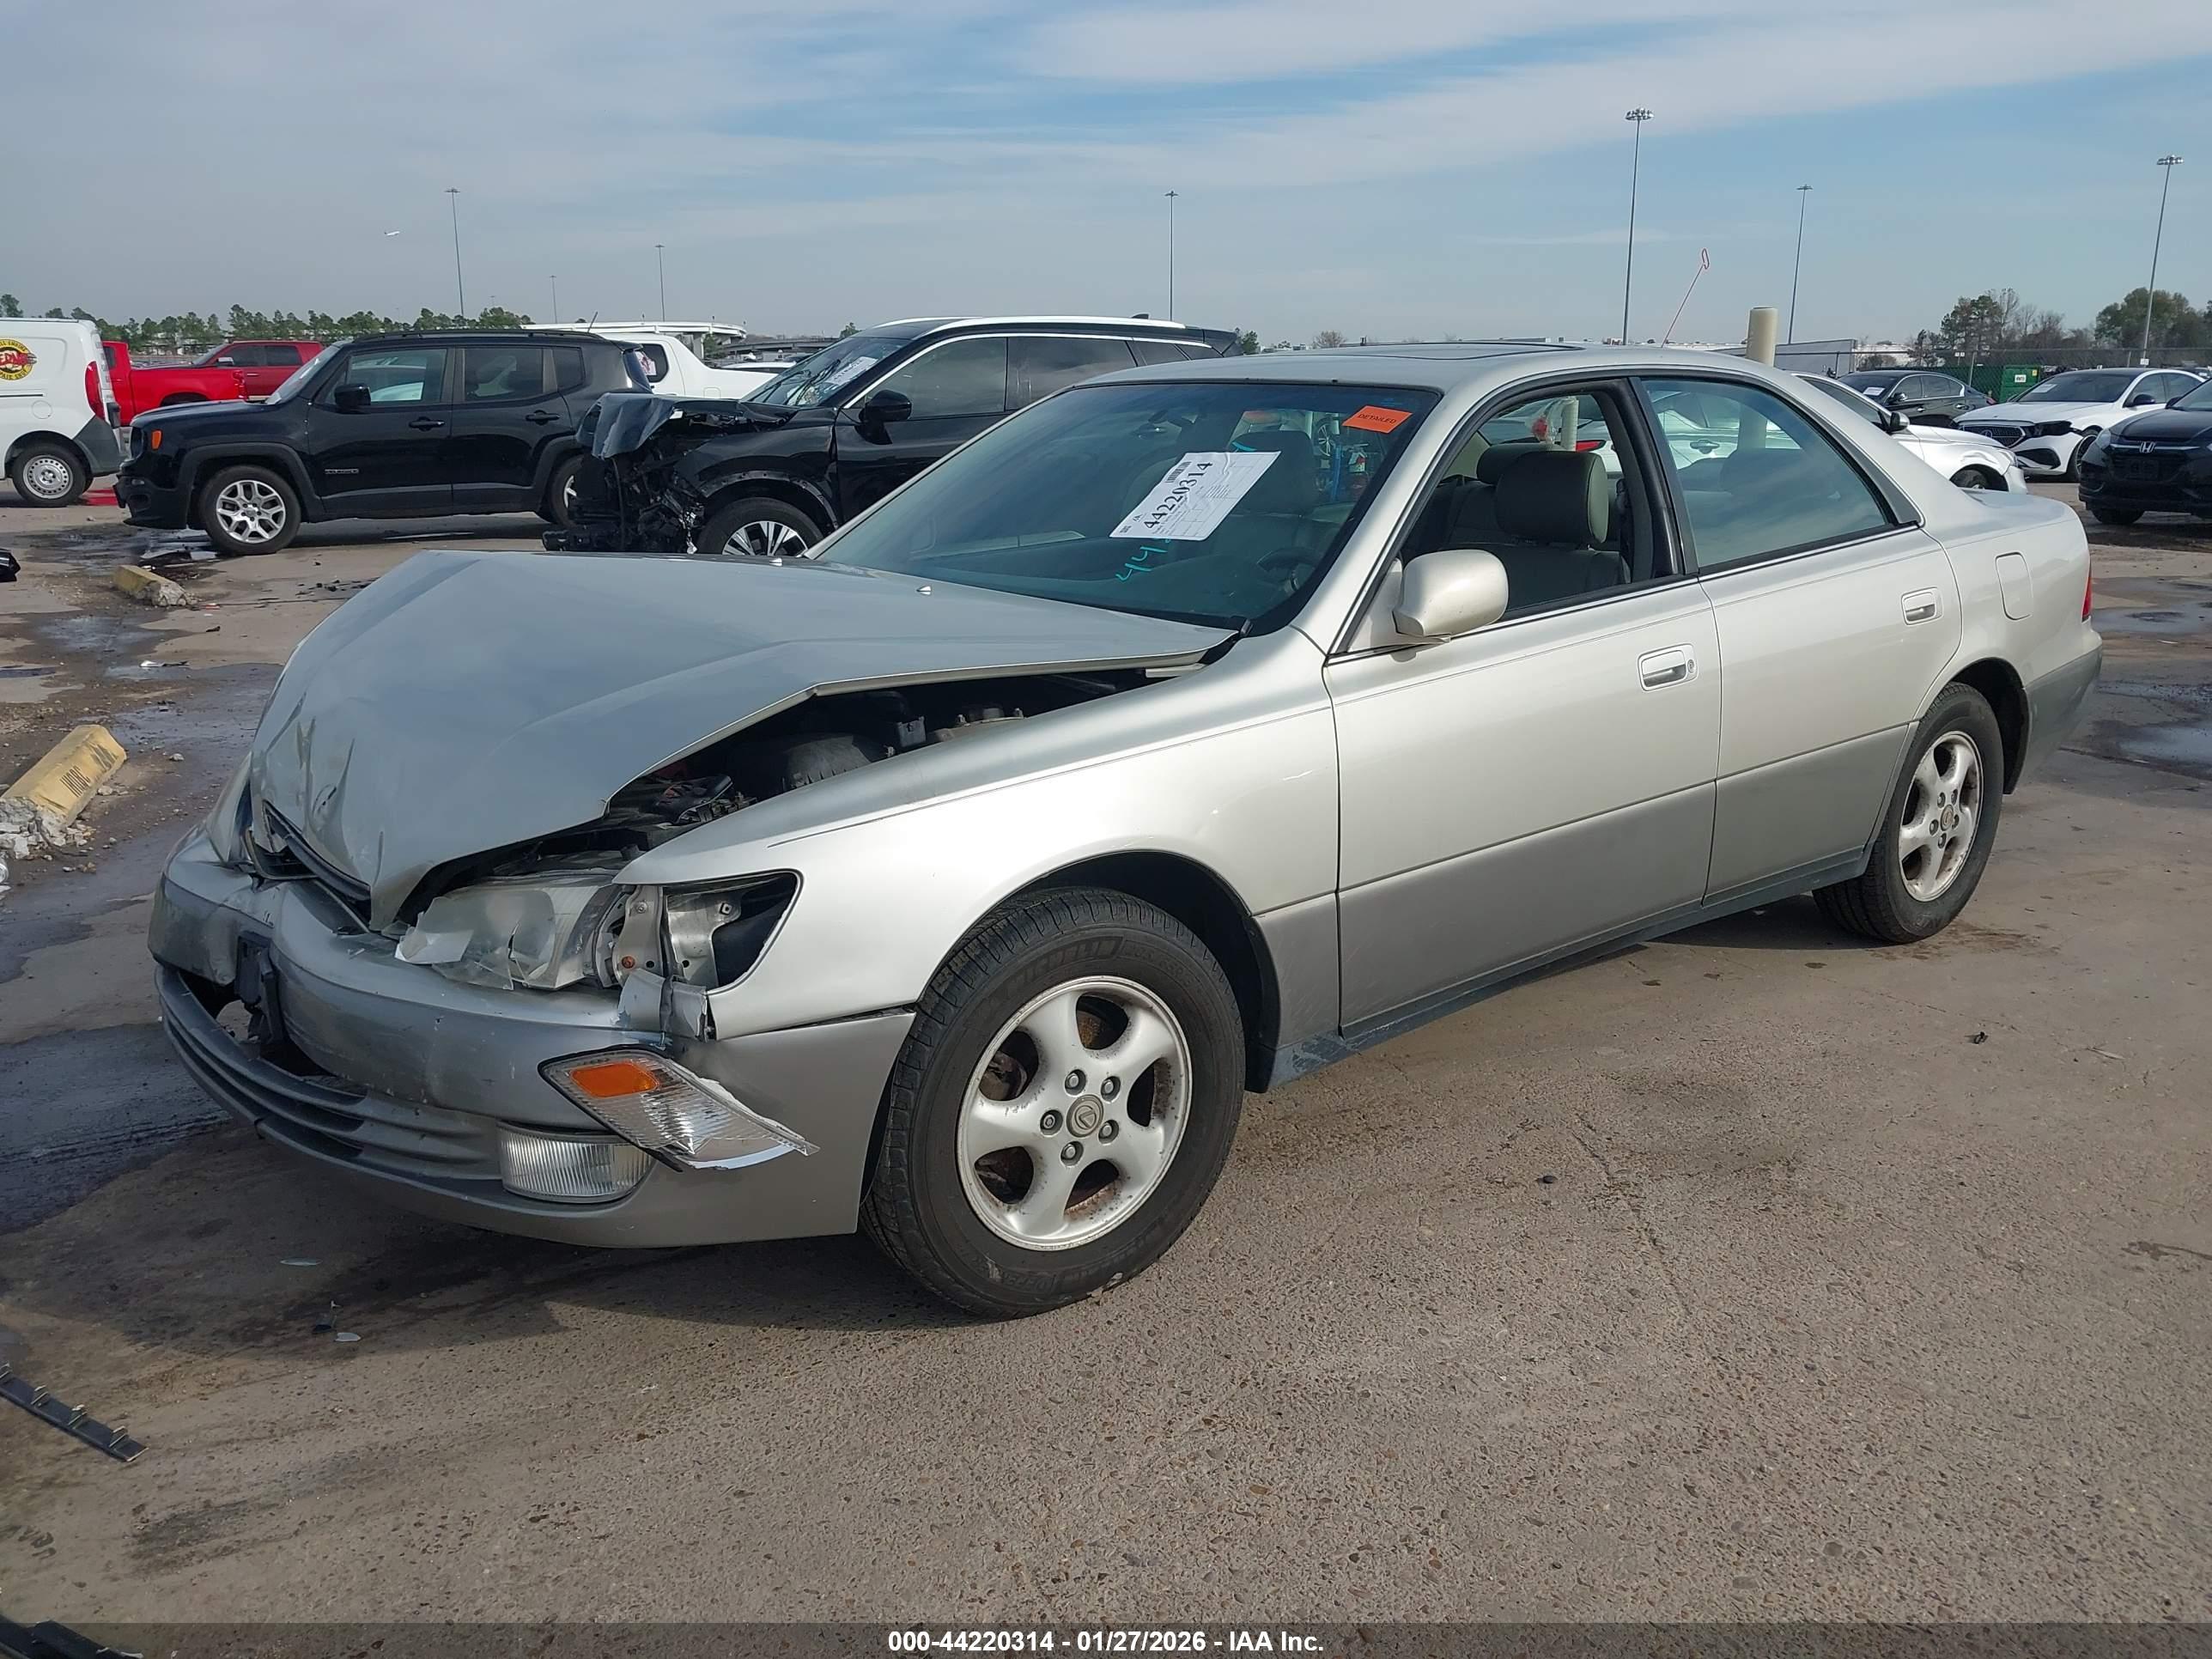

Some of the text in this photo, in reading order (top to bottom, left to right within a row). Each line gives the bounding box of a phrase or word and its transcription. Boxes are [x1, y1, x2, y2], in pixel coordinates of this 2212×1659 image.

[1358, 413, 1397, 424] DETAILED
[1144, 460, 1213, 529] 44220314
[1115, 538, 1171, 580] 44
